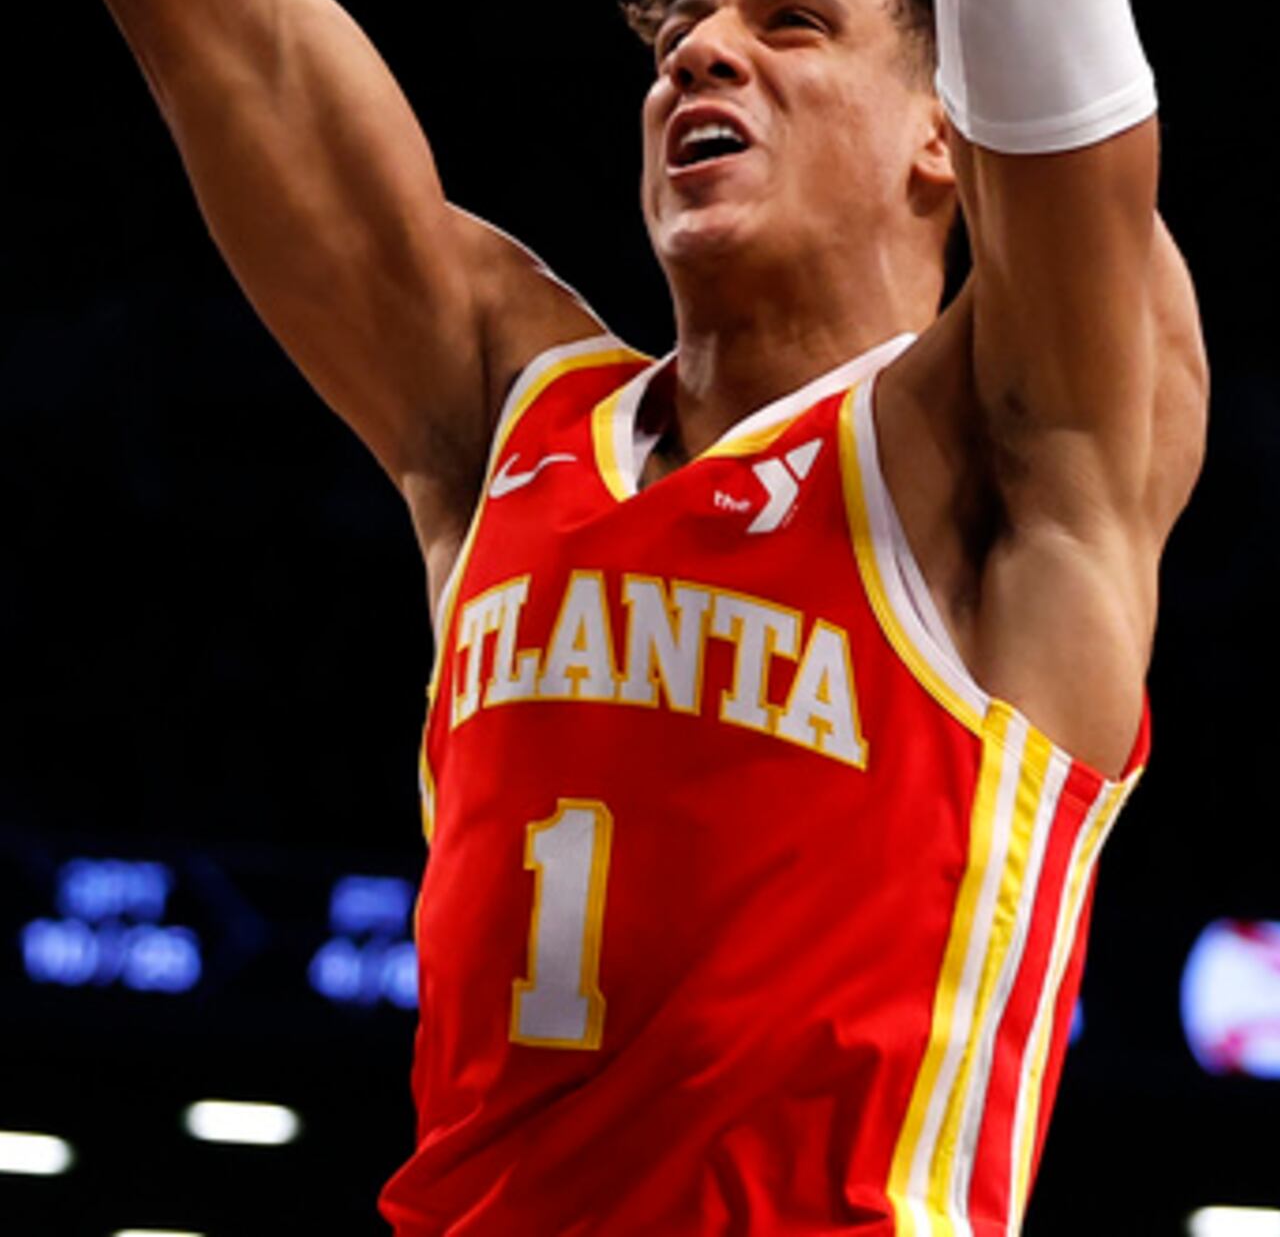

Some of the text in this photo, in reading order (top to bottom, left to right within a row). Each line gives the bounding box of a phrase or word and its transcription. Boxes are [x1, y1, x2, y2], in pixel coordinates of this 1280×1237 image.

[713, 490, 751, 514] the
[449, 568, 869, 772] TLANTA
[509, 797, 614, 1051] 1
